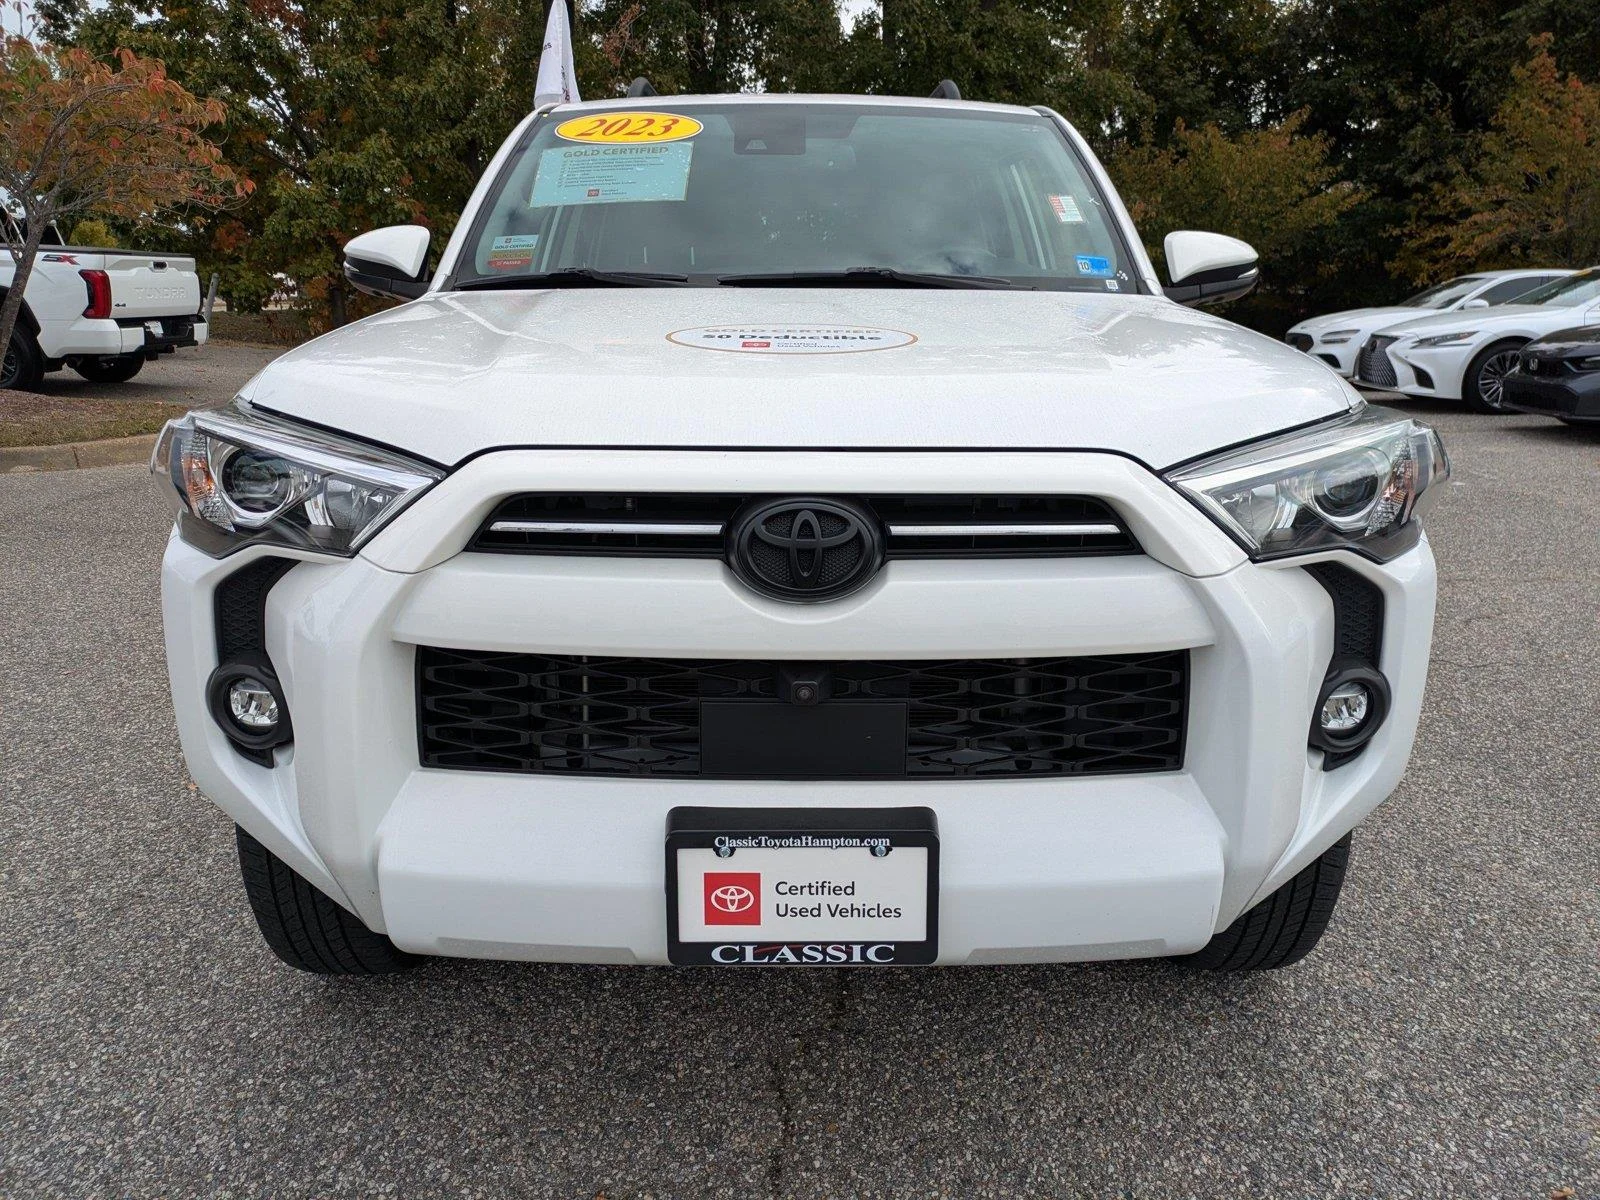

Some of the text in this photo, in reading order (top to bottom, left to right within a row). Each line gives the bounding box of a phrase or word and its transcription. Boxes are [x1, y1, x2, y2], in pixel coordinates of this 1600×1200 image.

[575, 118, 680, 137] 2023
[563, 146, 669, 158] GOLD CERTIFIED
[1079, 261, 1090, 271] 10
[134, 287, 187, 300] TUNDRA
[714, 836, 890, 850] ClassicToyotaHampton.com
[775, 881, 856, 897] Certified
[775, 903, 902, 919] Used Vehicles
[711, 944, 895, 964] CLASSIC
